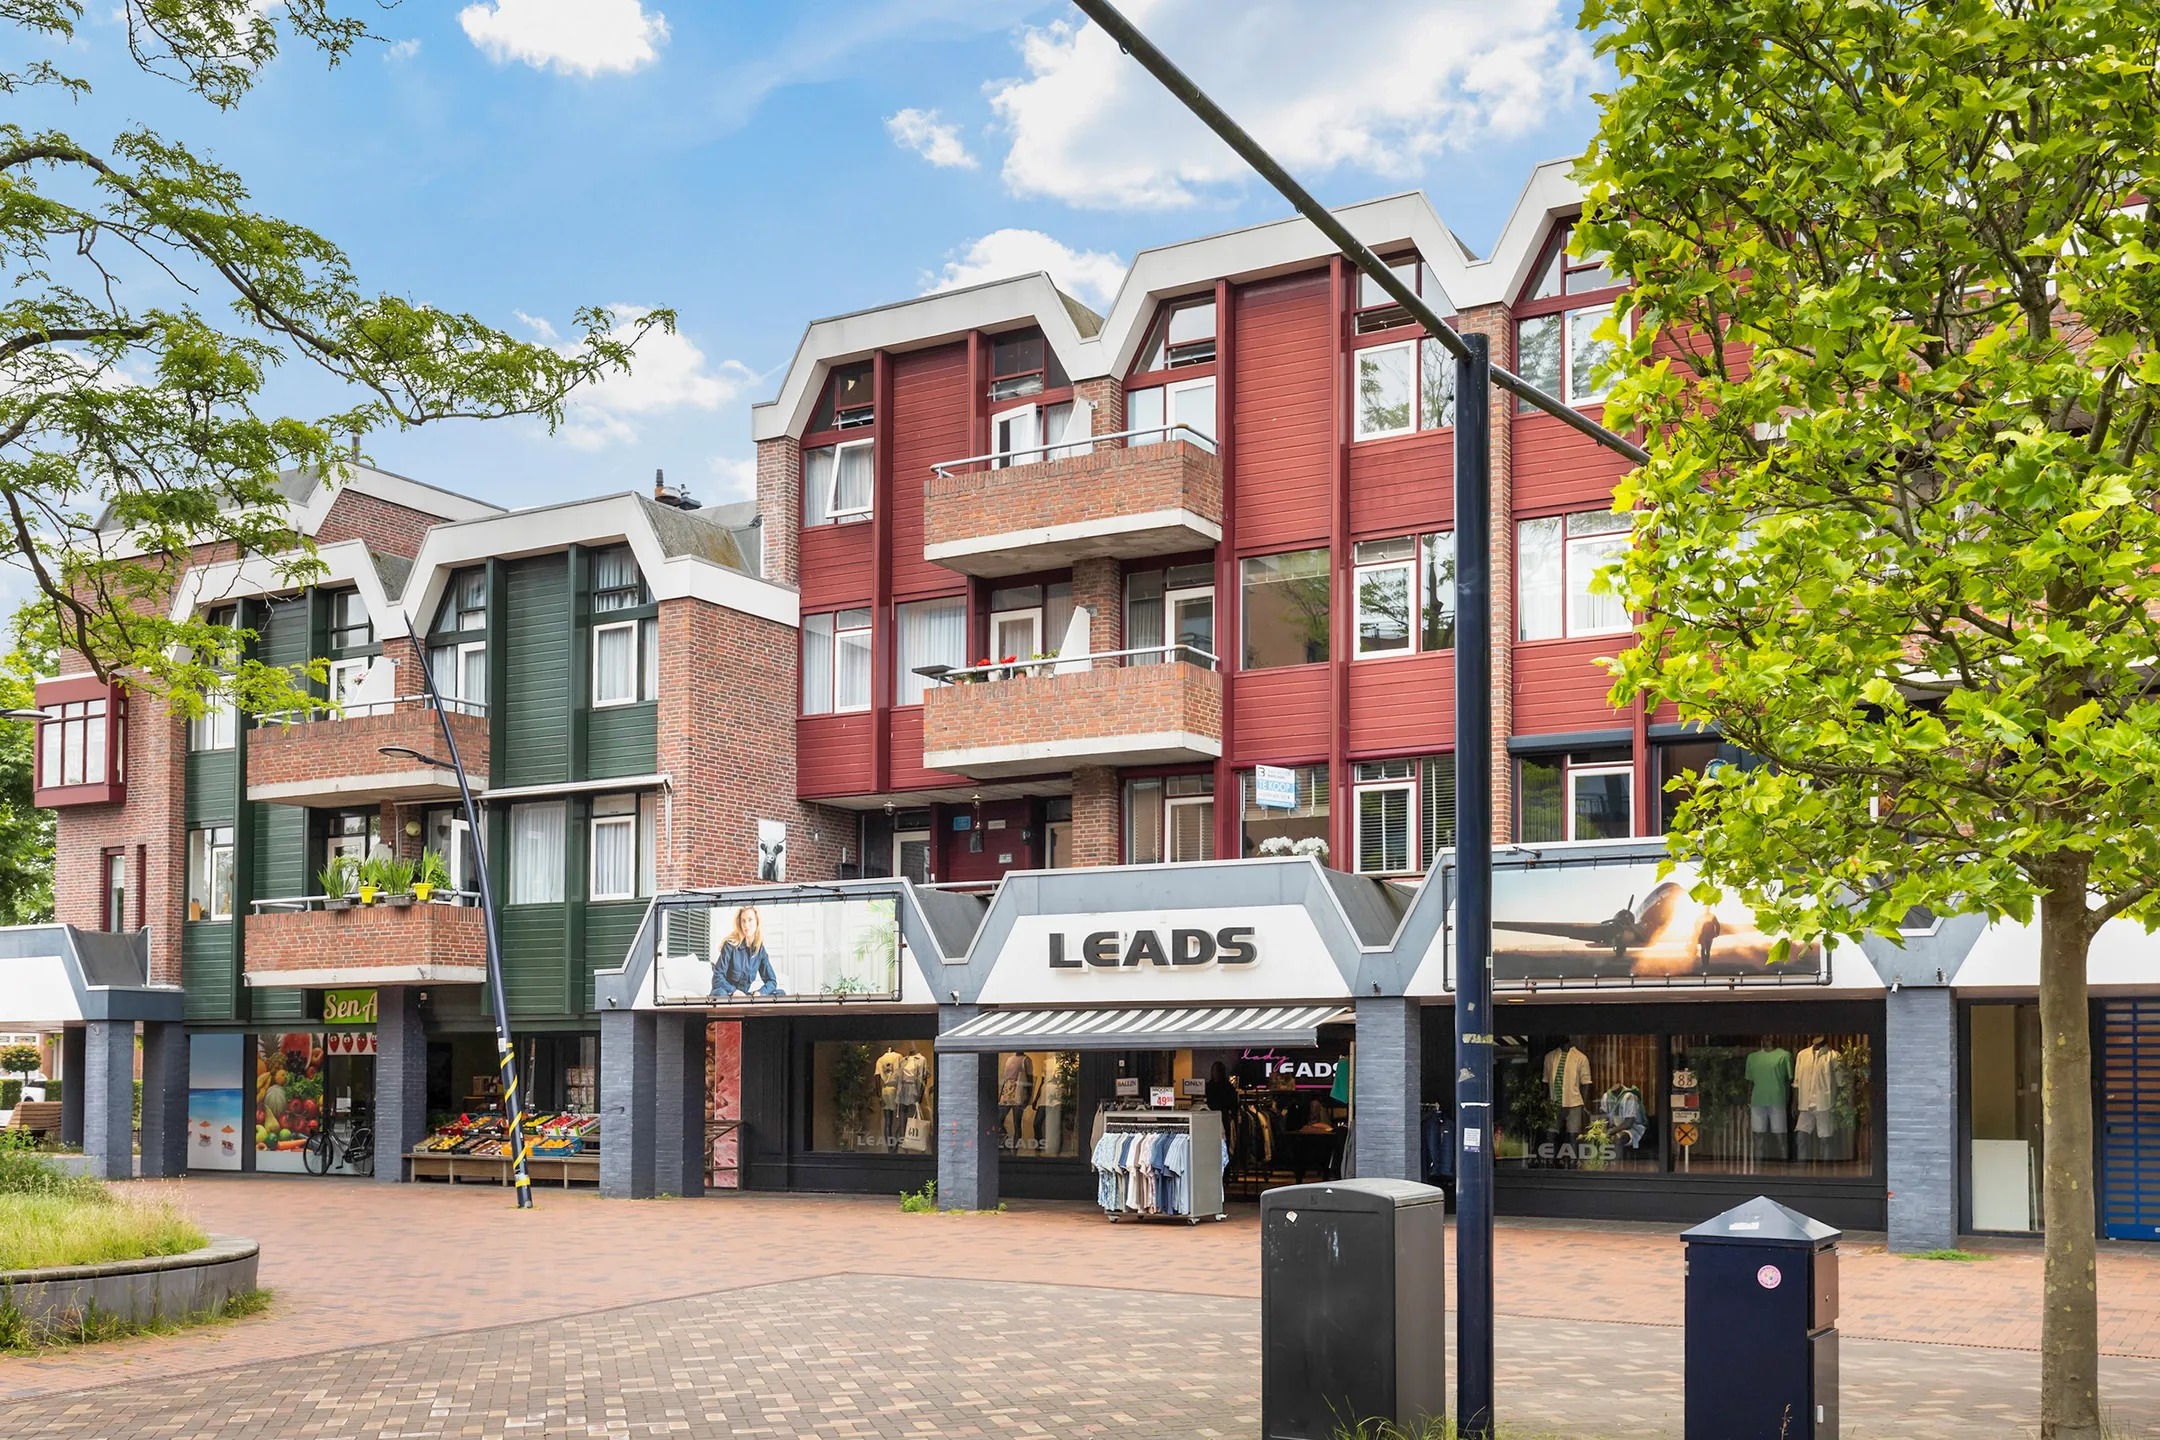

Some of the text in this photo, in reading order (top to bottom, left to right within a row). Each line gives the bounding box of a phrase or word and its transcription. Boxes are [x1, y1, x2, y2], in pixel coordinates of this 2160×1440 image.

[1049, 927, 1258, 968] LEADS
[323, 994, 362, 1019] Sen
[1241, 1047, 1290, 1072] lady
[1523, 1142, 1617, 1160] LEADS
